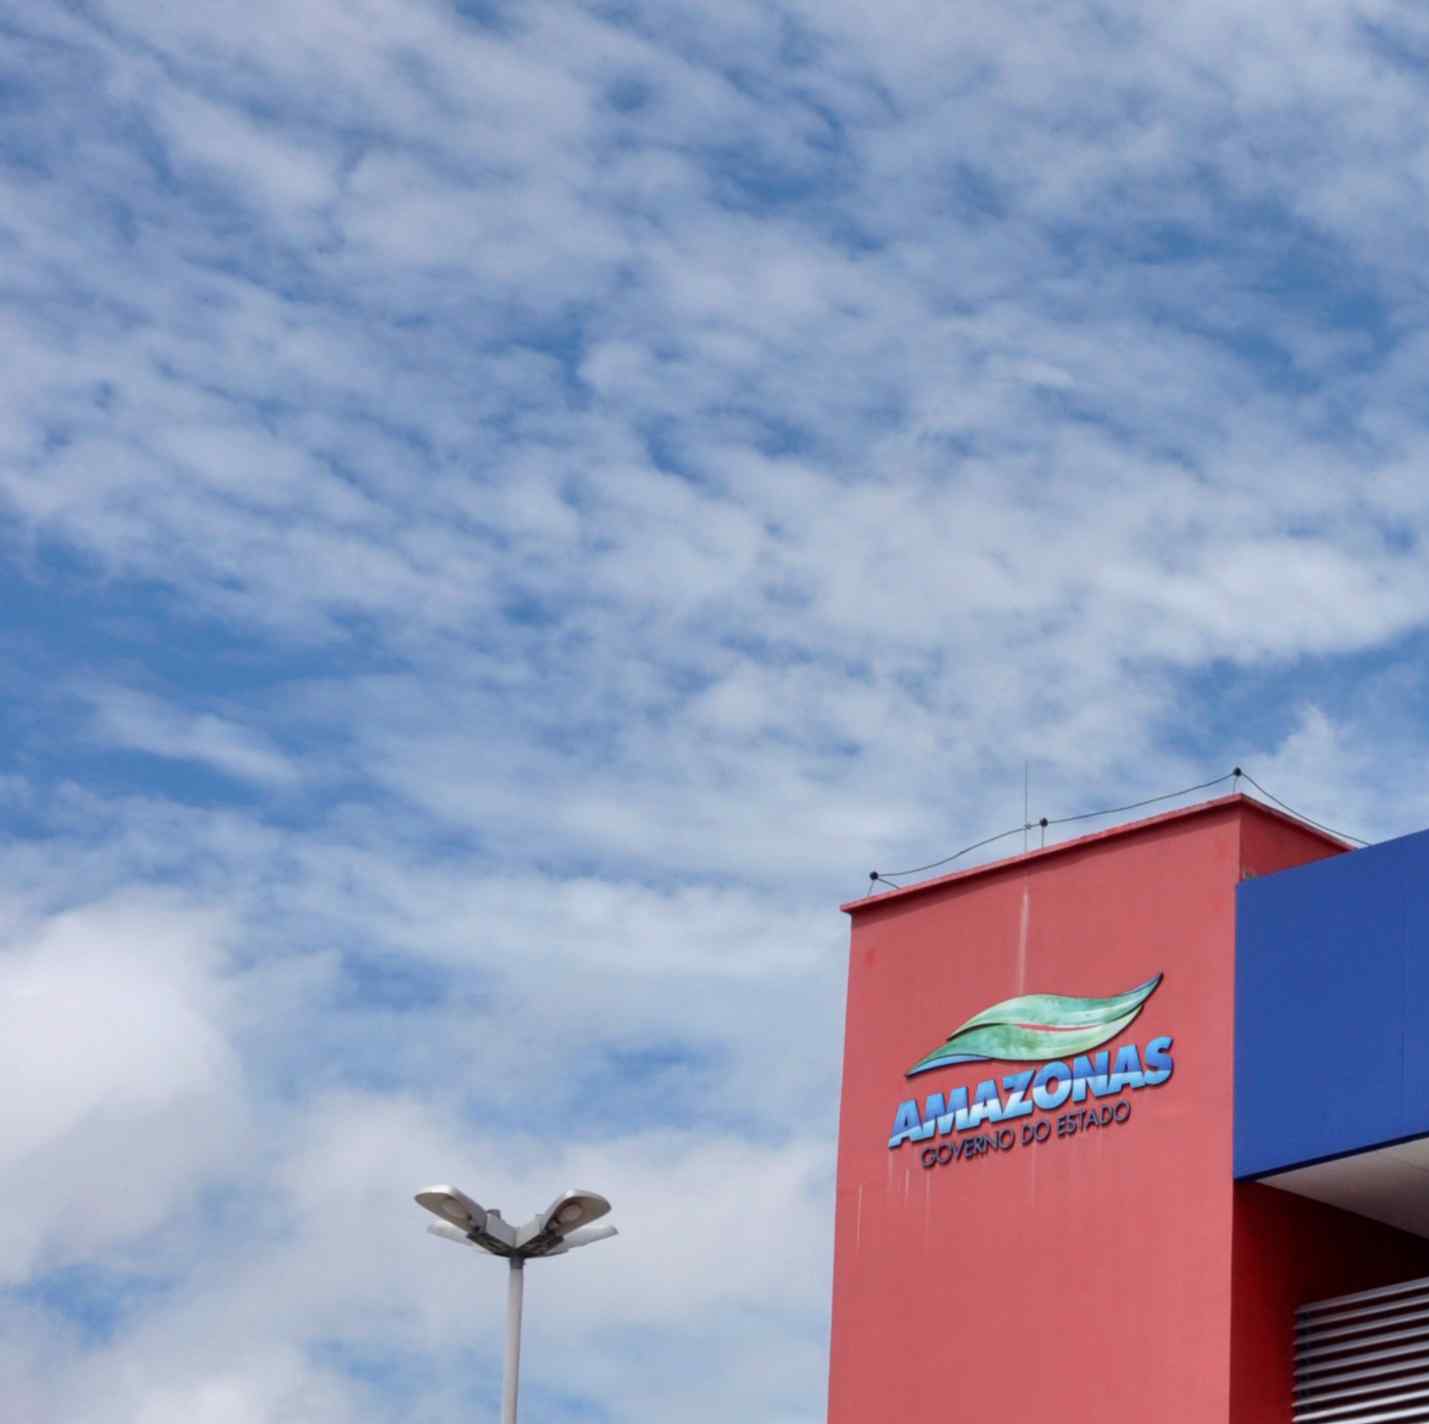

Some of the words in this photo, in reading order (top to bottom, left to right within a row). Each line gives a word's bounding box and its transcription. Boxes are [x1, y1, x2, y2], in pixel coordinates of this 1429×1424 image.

[888, 1036, 1174, 1149] AMAZONAS
[920, 1130, 1015, 1169] GOVERNO
[1021, 1122, 1052, 1146] DO
[1057, 1101, 1131, 1137] ESTADO
